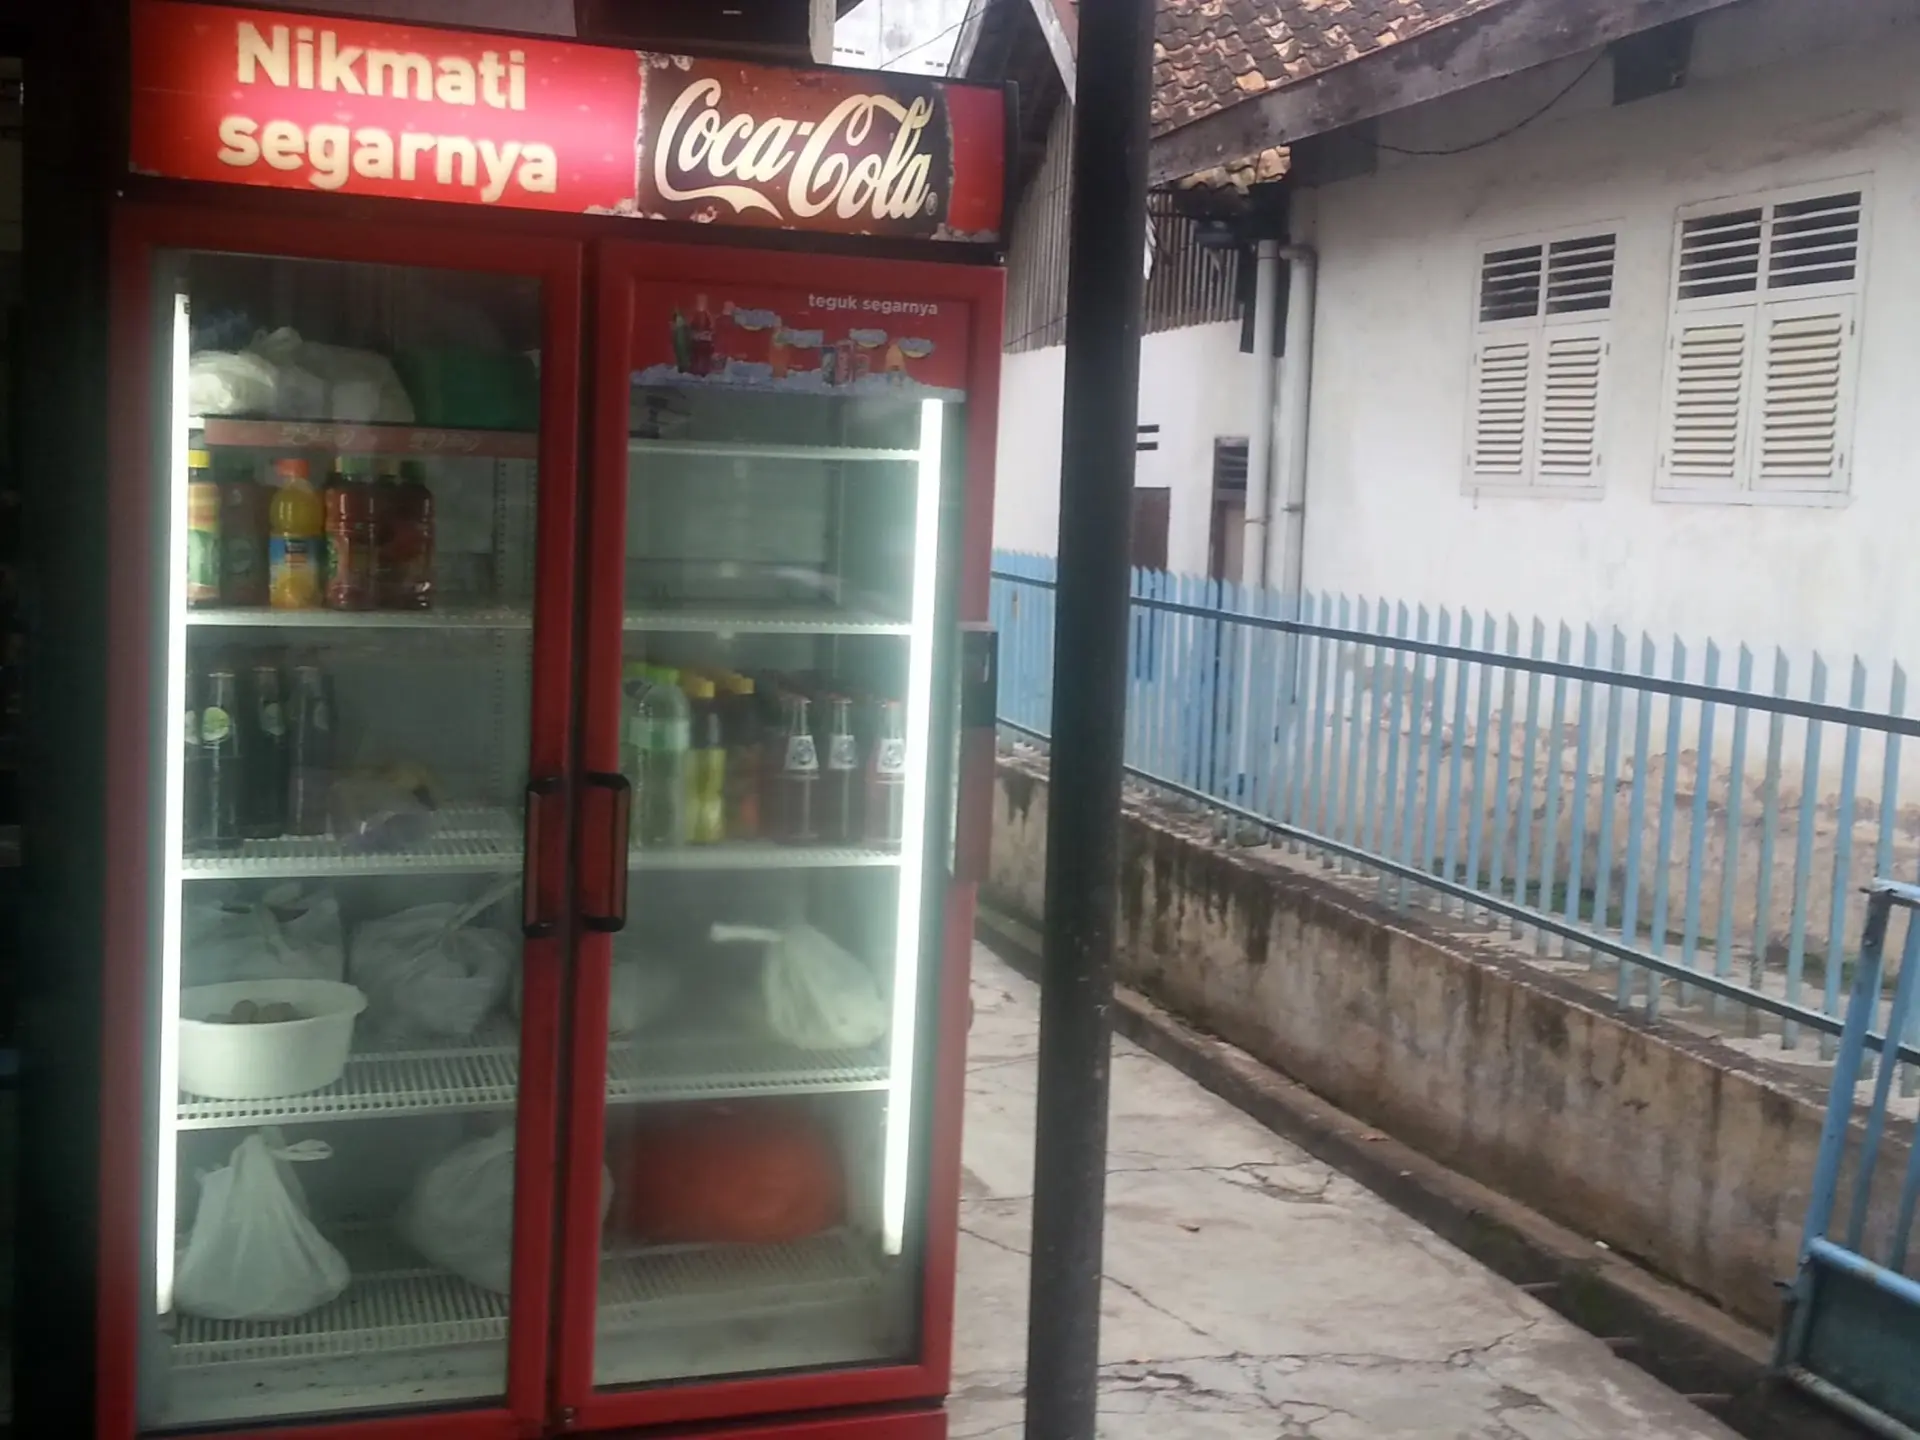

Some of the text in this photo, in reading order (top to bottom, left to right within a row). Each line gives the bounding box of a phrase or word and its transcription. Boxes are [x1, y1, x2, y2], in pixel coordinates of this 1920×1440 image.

[236, 22, 527, 111] Nikmati
[216, 115, 558, 203] segarnya
[654, 78, 936, 220] Coca-Cola
[808, 293, 938, 316] teguk segarnya
